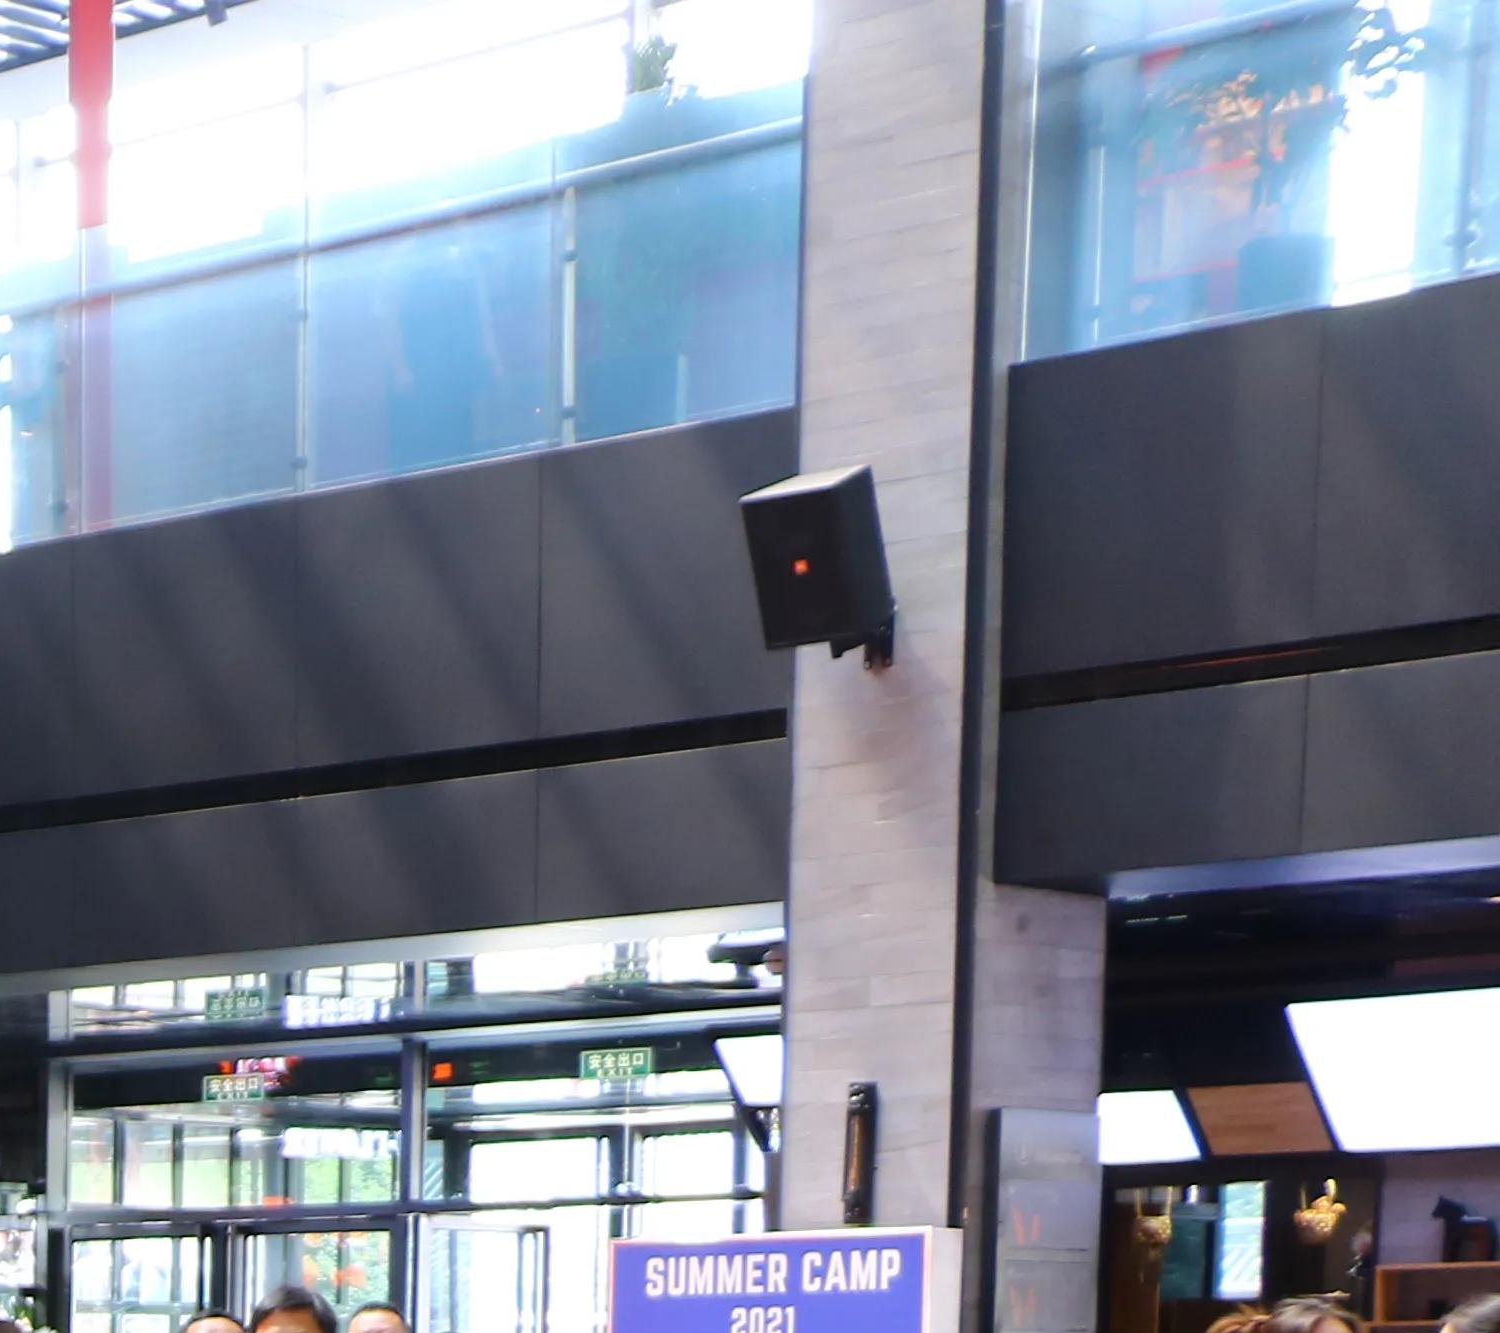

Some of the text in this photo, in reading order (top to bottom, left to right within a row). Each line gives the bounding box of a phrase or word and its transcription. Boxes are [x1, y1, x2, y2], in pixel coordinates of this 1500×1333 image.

[588, 1052, 645, 1069] 安全出口
[208, 1077, 260, 1094] 安全出口
[645, 1248, 901, 1297] SUMMER CAMP
